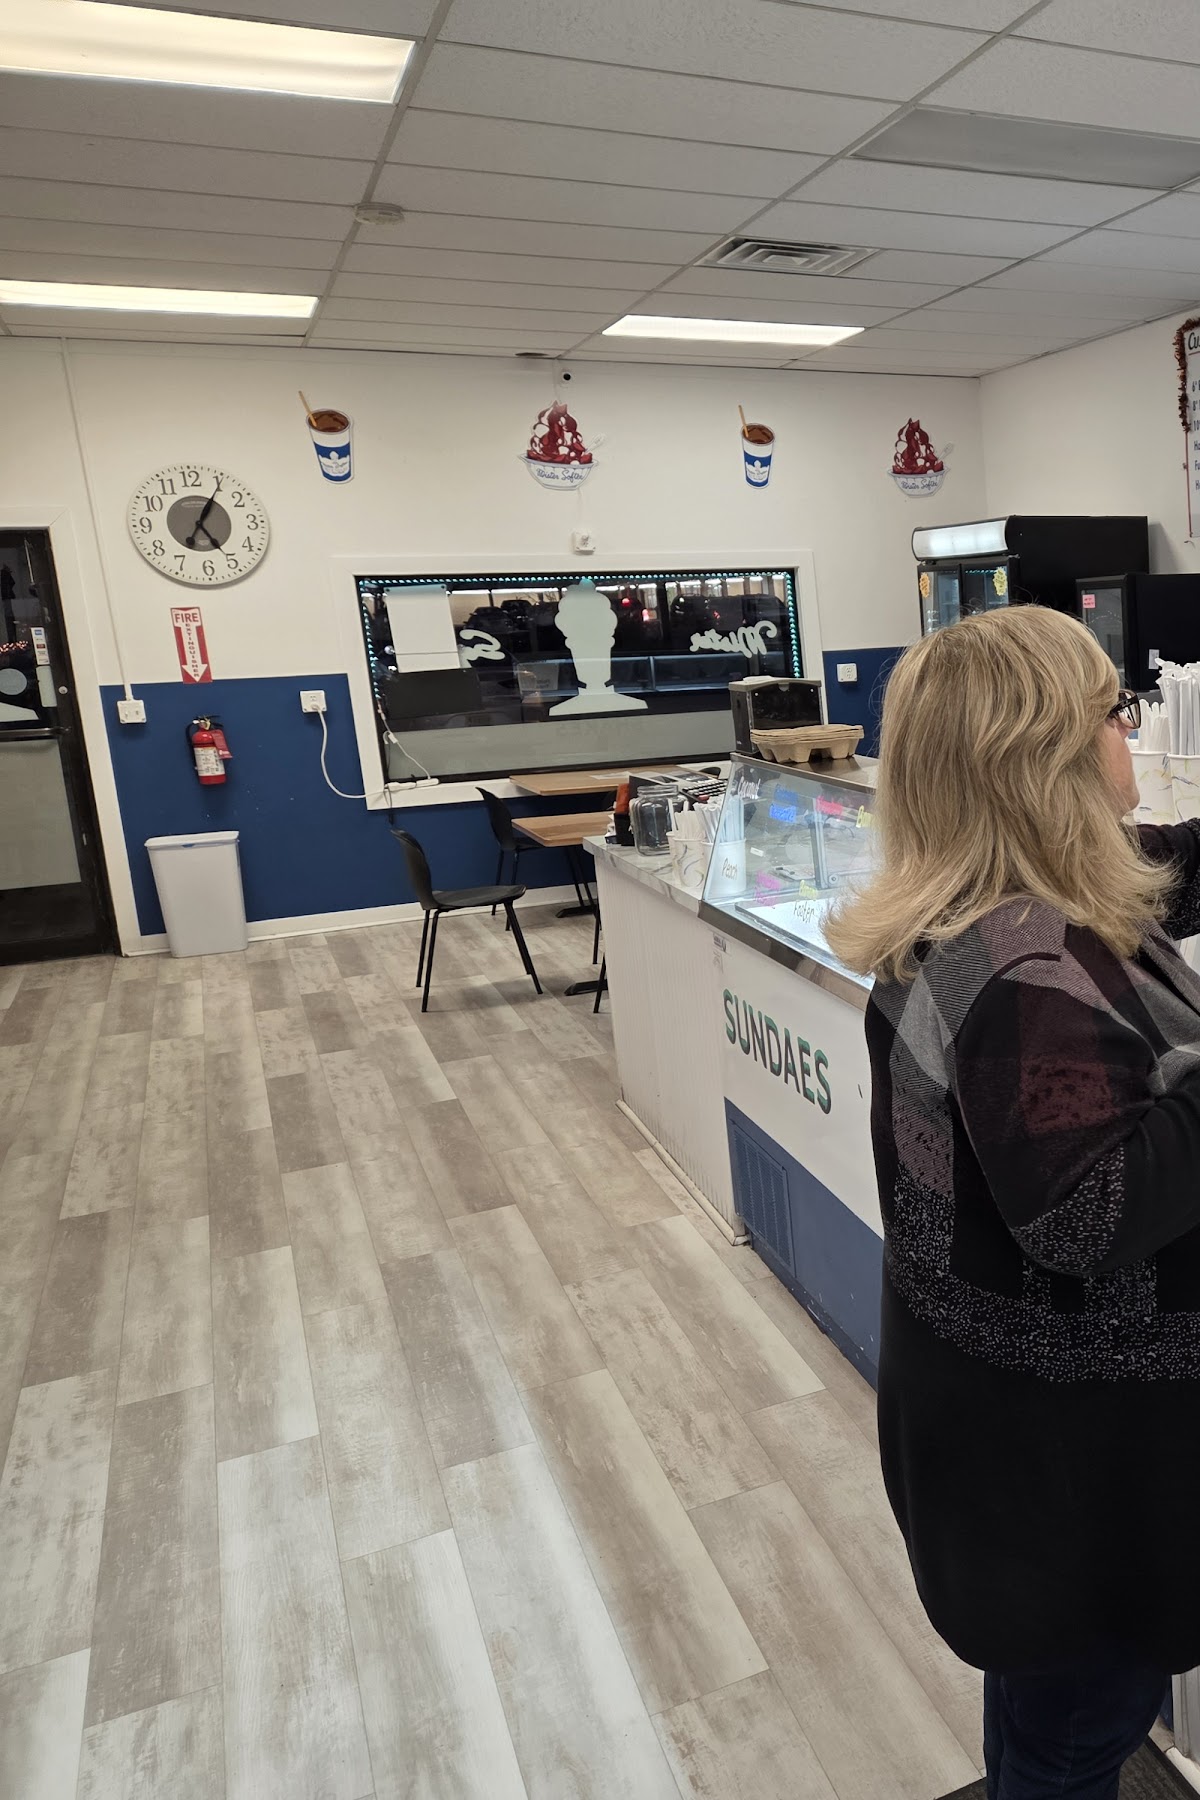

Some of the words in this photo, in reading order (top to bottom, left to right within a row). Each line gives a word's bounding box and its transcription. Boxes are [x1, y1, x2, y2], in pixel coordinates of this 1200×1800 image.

[158, 478, 177, 495] 11
[180, 471, 202, 487] 12
[213, 475, 223, 492] 1
[143, 495, 163, 512] 10
[231, 491, 245, 508] 2
[140, 517, 152, 534] 9
[246, 514, 258, 530] 3
[152, 539, 165, 556] 8
[242, 536, 254, 552] 4
[174, 555, 185, 571] 7
[202, 560, 215, 576] 6
[225, 553, 238, 569] 5
[174, 613, 199, 623] FIRE
[185, 624, 200, 677] EXTINGUISHER
[723, 989, 831, 1114] SUNDAES
